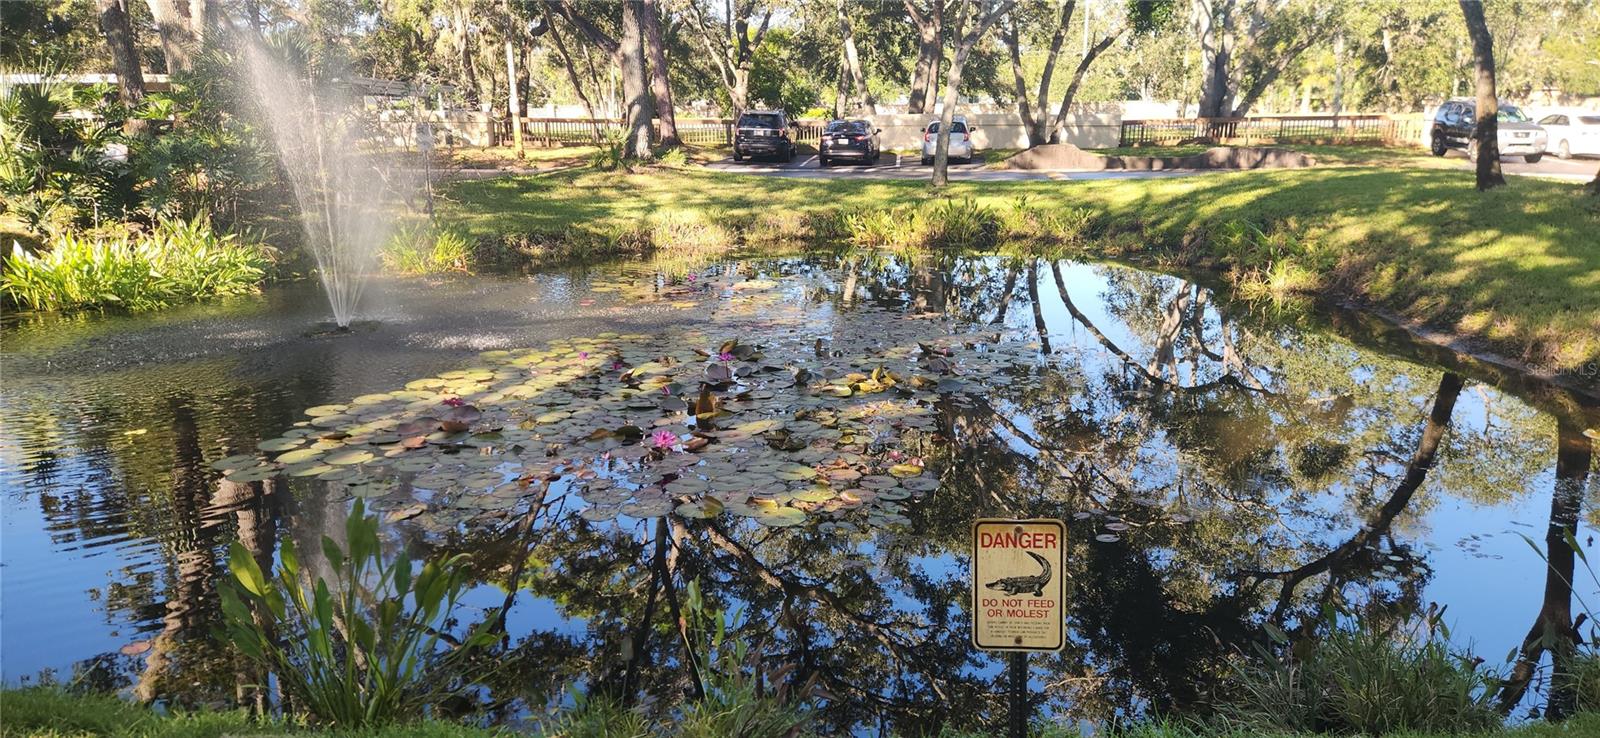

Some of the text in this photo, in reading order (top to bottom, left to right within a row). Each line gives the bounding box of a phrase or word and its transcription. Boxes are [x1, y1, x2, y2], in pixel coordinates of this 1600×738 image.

[981, 533, 1056, 549] DANGER
[982, 599, 1054, 608] DO NOT FEED
[987, 609, 1049, 618] OR MOLEST
